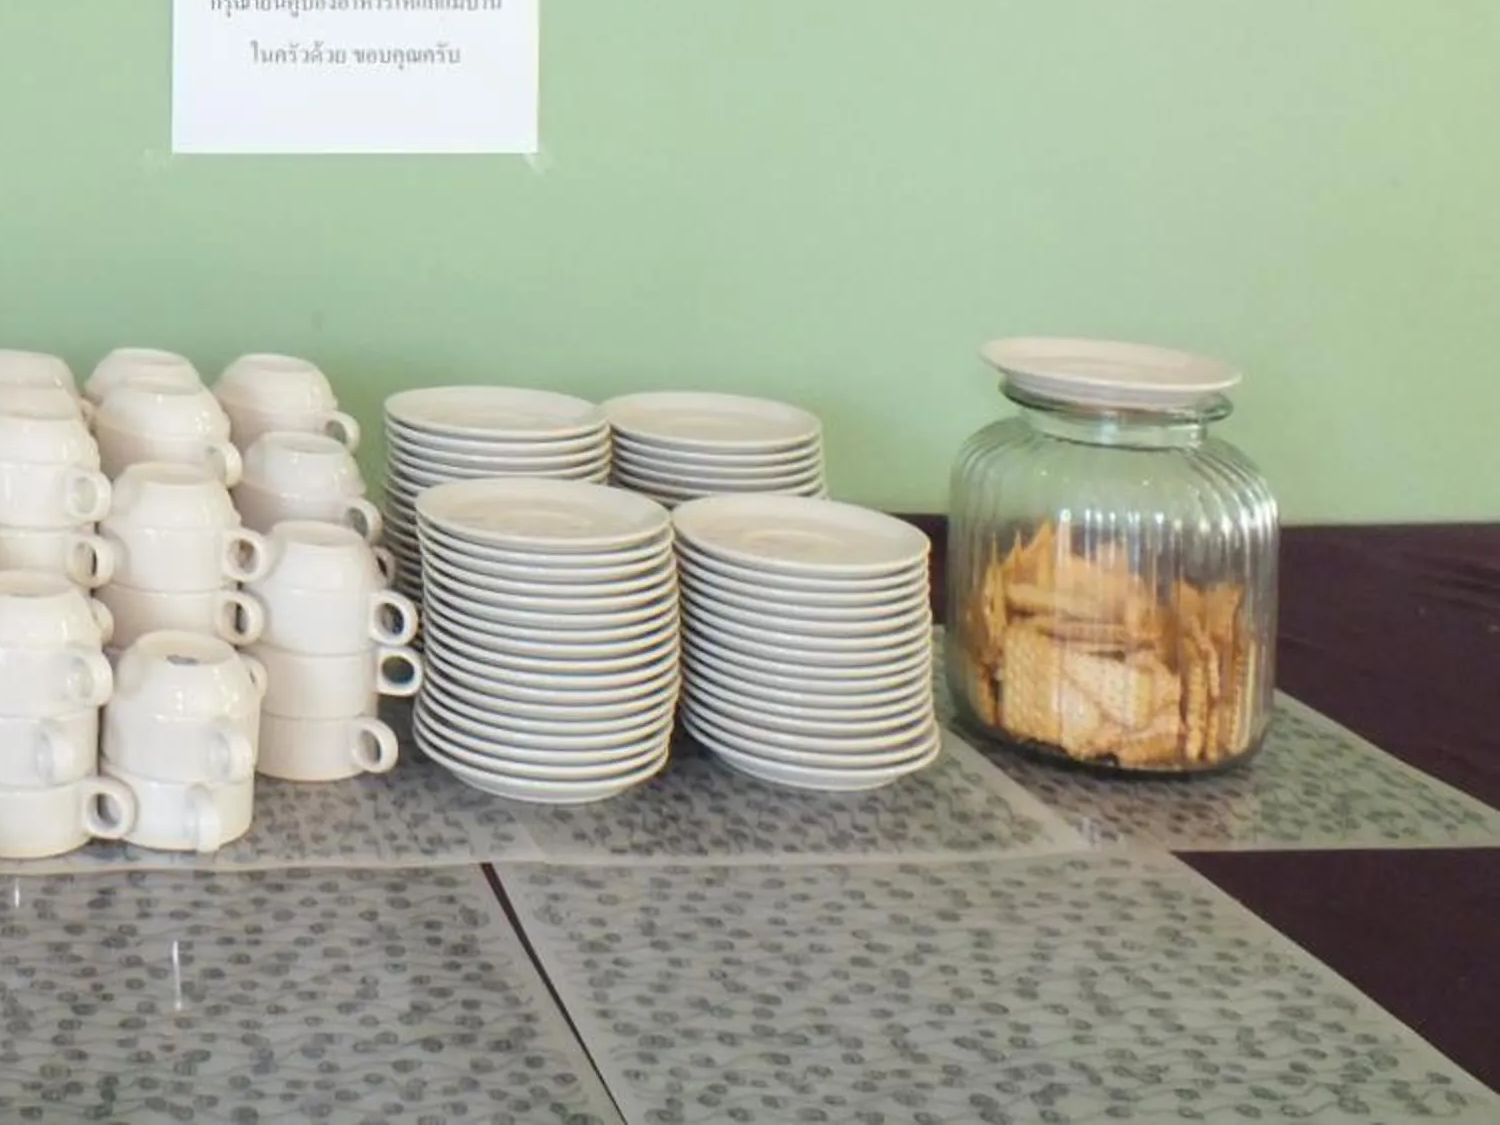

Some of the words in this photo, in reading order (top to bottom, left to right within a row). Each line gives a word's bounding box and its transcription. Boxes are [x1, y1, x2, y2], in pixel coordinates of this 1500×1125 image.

[249, 39, 348, 65] ในครัวด้วย
[352, 41, 461, 71] ขอบคุณครับ
